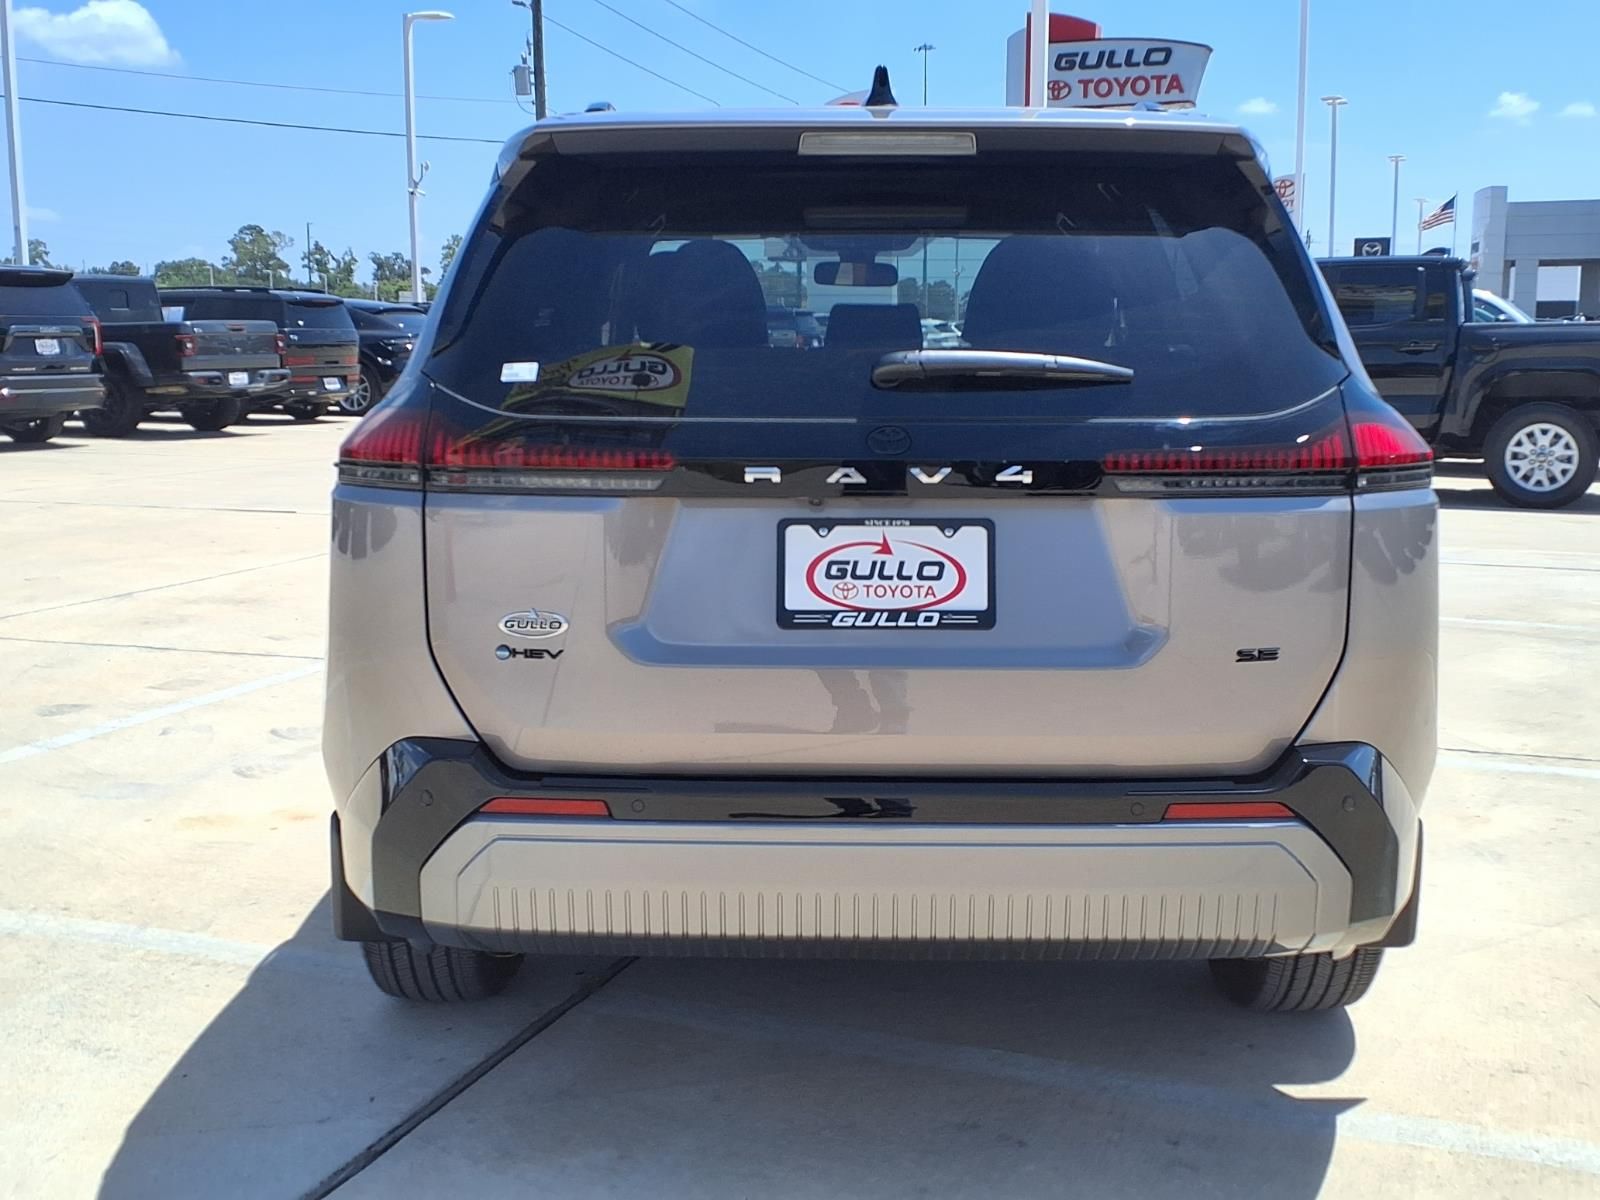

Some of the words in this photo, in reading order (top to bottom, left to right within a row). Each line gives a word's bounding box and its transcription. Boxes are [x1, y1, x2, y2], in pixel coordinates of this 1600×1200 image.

[1054, 47, 1172, 71] GULLO
[1077, 74, 1185, 99] TOYOTA
[744, 465, 1033, 484] RAV4
[824, 560, 946, 581] GULLO
[863, 584, 937, 599] TOYOTA
[504, 619, 562, 630] GULLO
[832, 611, 941, 627] GULLO
[511, 647, 564, 660] HEV
[1235, 647, 1280, 663] SE
